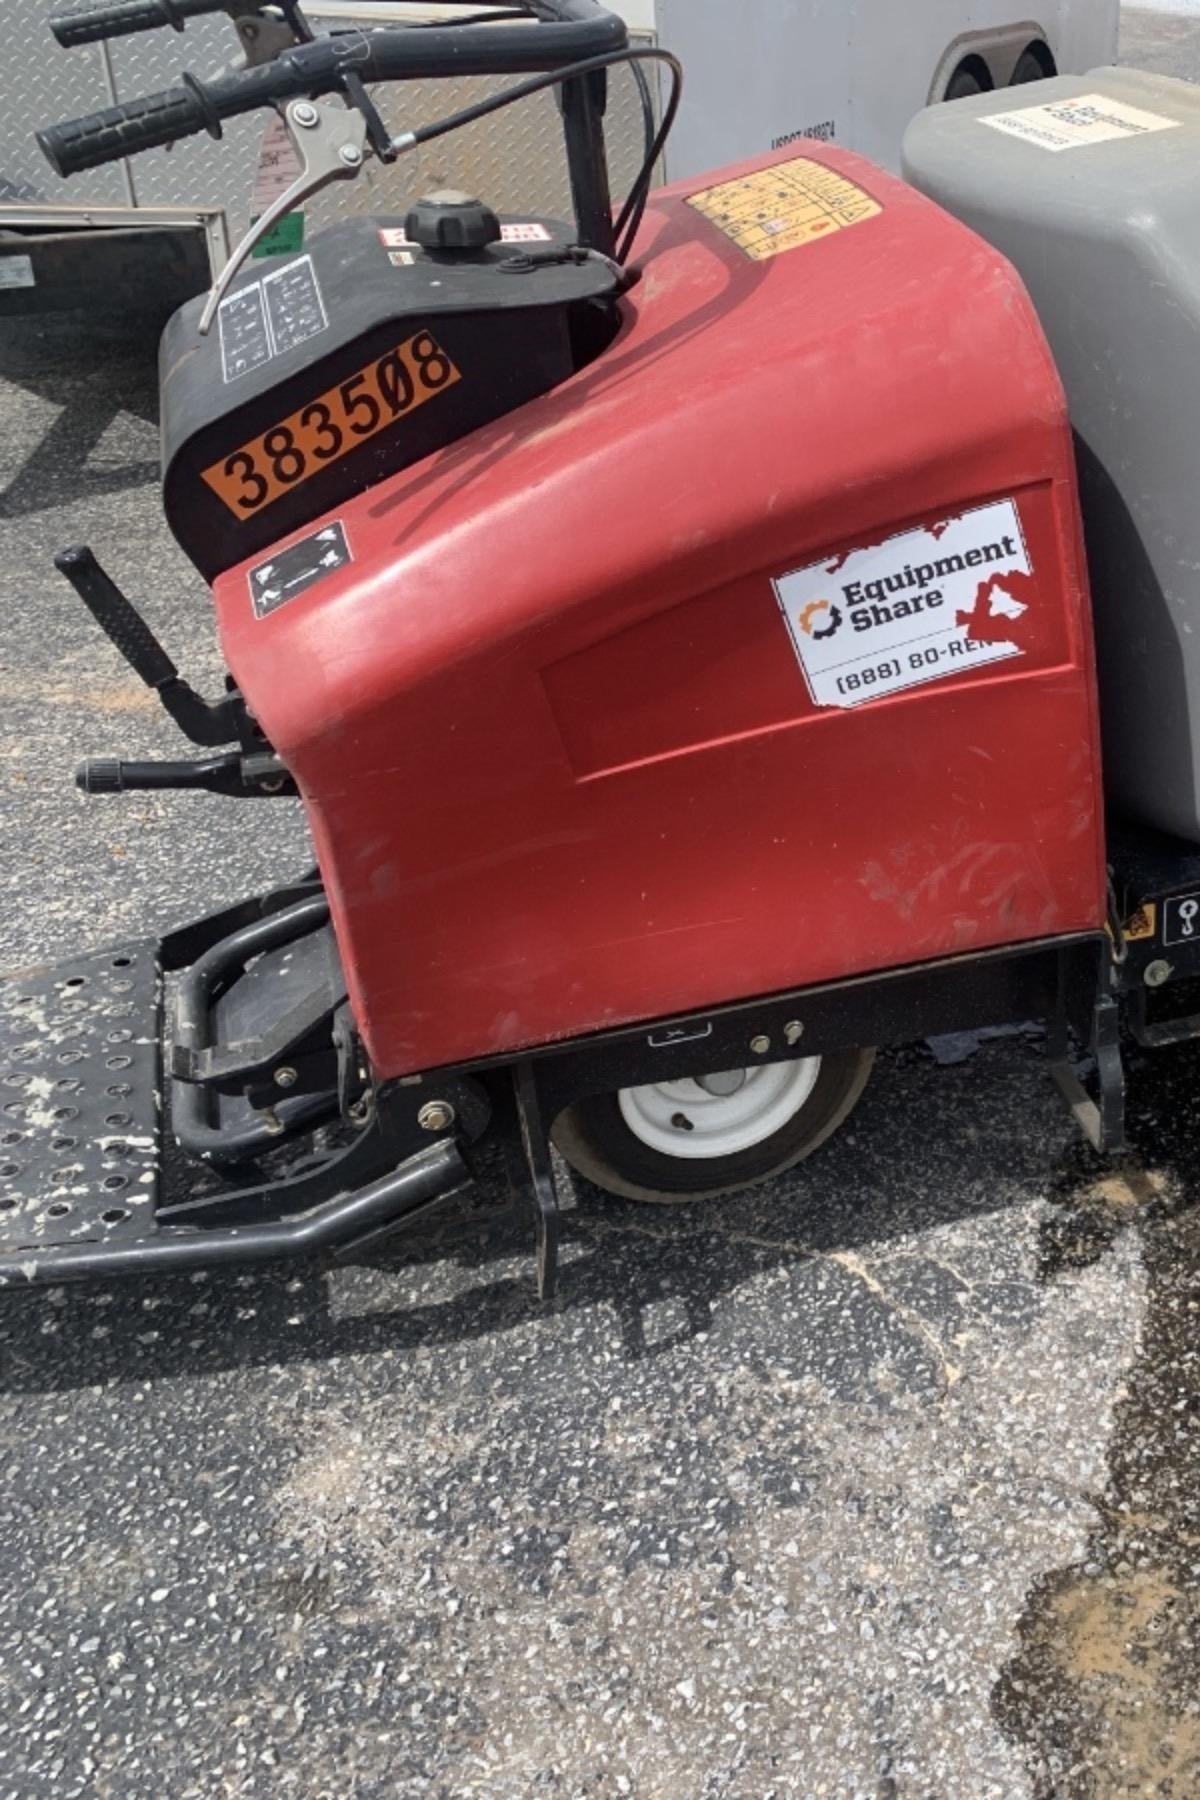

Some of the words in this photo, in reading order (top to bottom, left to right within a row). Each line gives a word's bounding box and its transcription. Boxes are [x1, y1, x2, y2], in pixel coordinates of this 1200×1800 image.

[223, 332, 452, 509] 383508
[840, 534, 1018, 607] Equipment
[849, 589, 944, 633] Share
[835, 658, 901, 695] (888)
